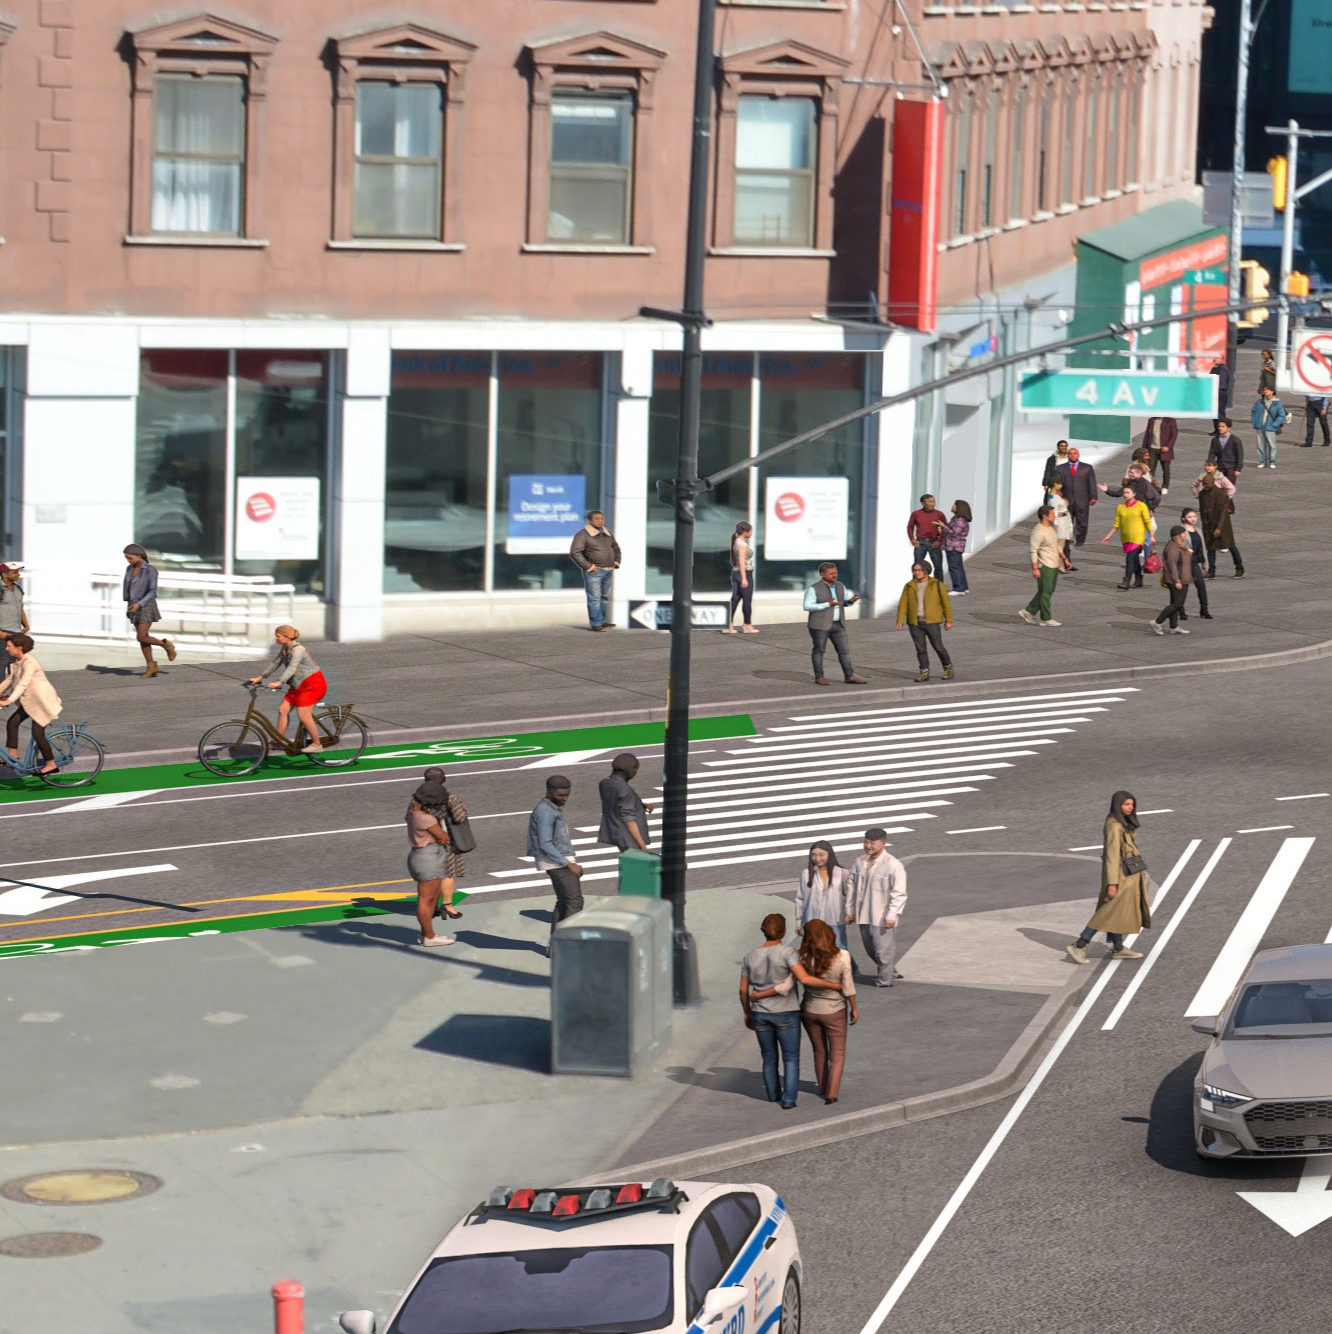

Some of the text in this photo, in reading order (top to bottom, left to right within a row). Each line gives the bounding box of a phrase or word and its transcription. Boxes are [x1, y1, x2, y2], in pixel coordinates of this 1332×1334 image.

[1075, 379, 1159, 406] 4 Av
[521, 500, 550, 513] Design
